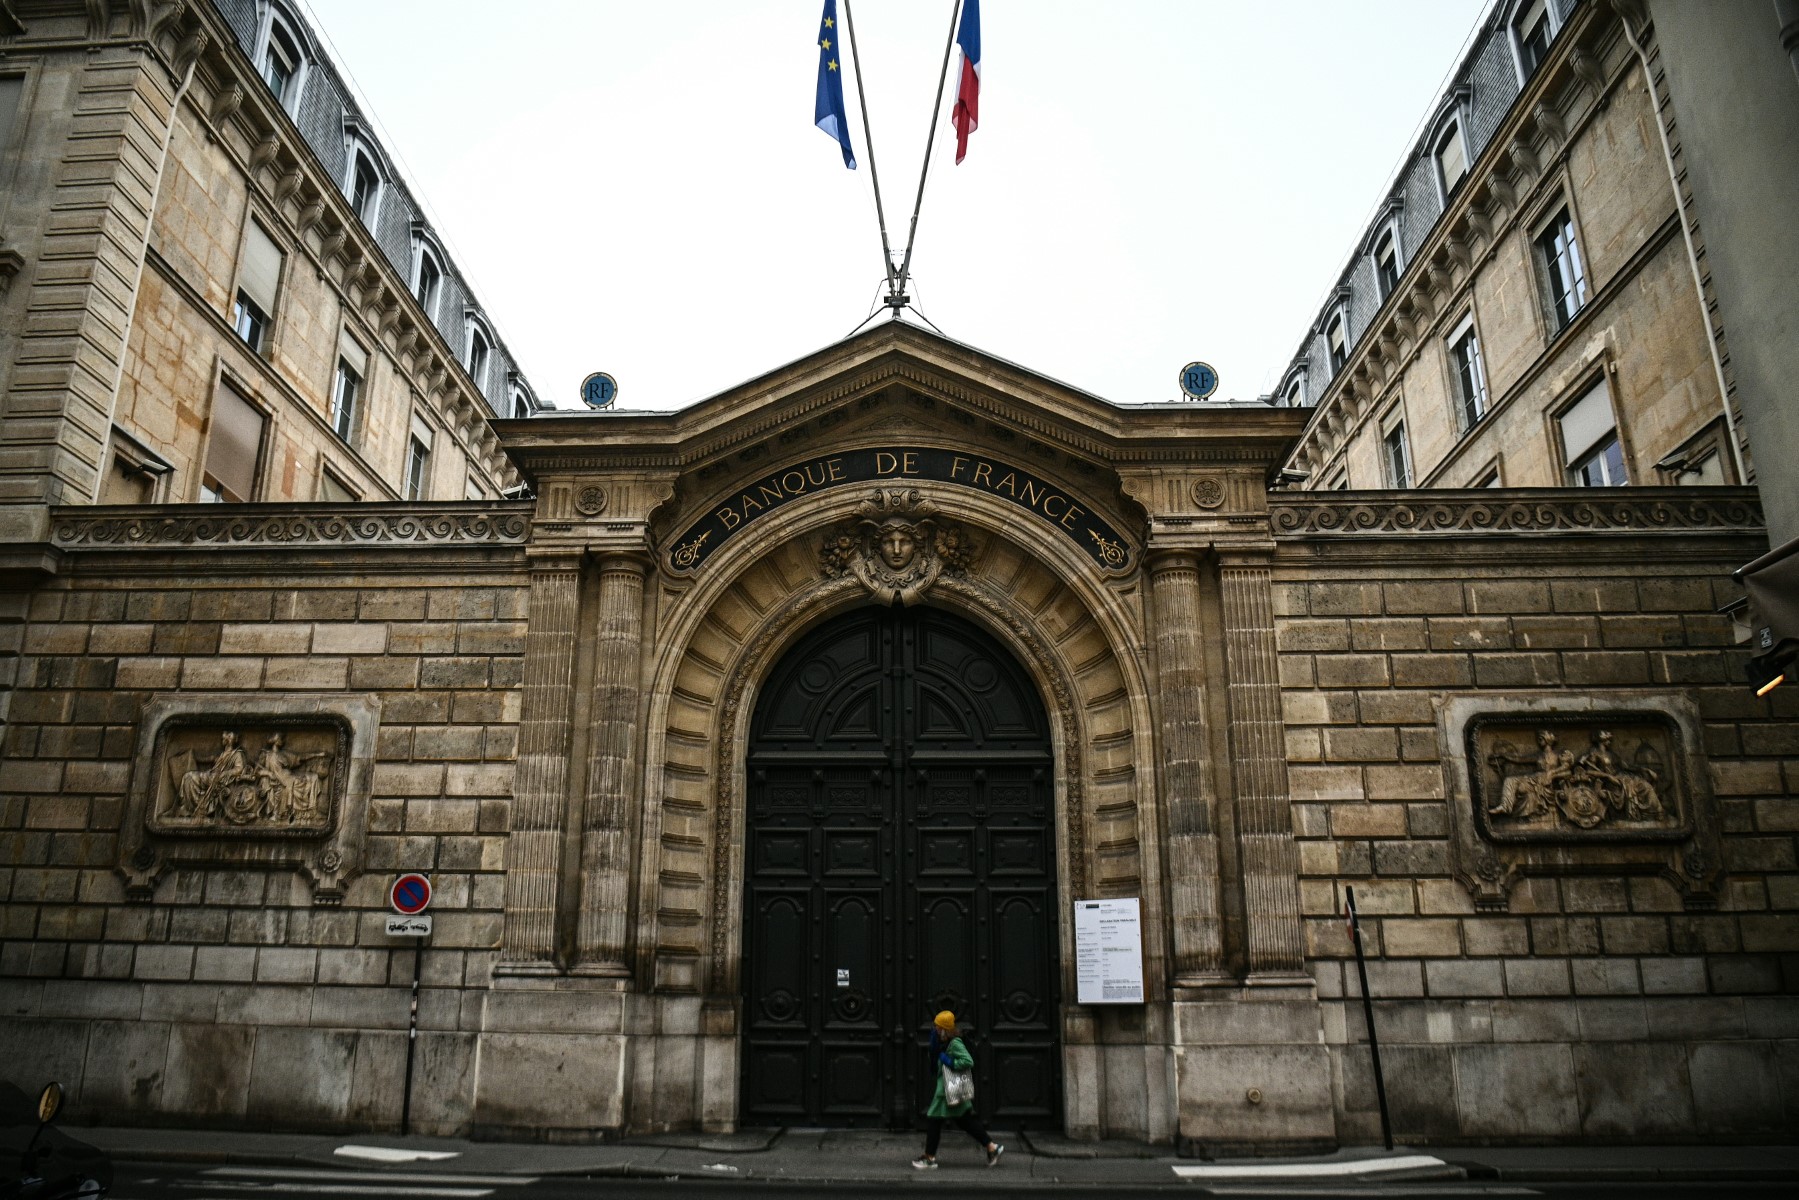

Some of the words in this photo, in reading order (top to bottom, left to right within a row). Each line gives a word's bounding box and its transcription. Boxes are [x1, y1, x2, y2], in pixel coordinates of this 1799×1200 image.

[1187, 372, 1210, 389] RF
[588, 382, 611, 399] RF
[716, 458, 847, 531] BANQUE
[875, 452, 920, 475] DE
[950, 456, 1085, 531] FRANCE
